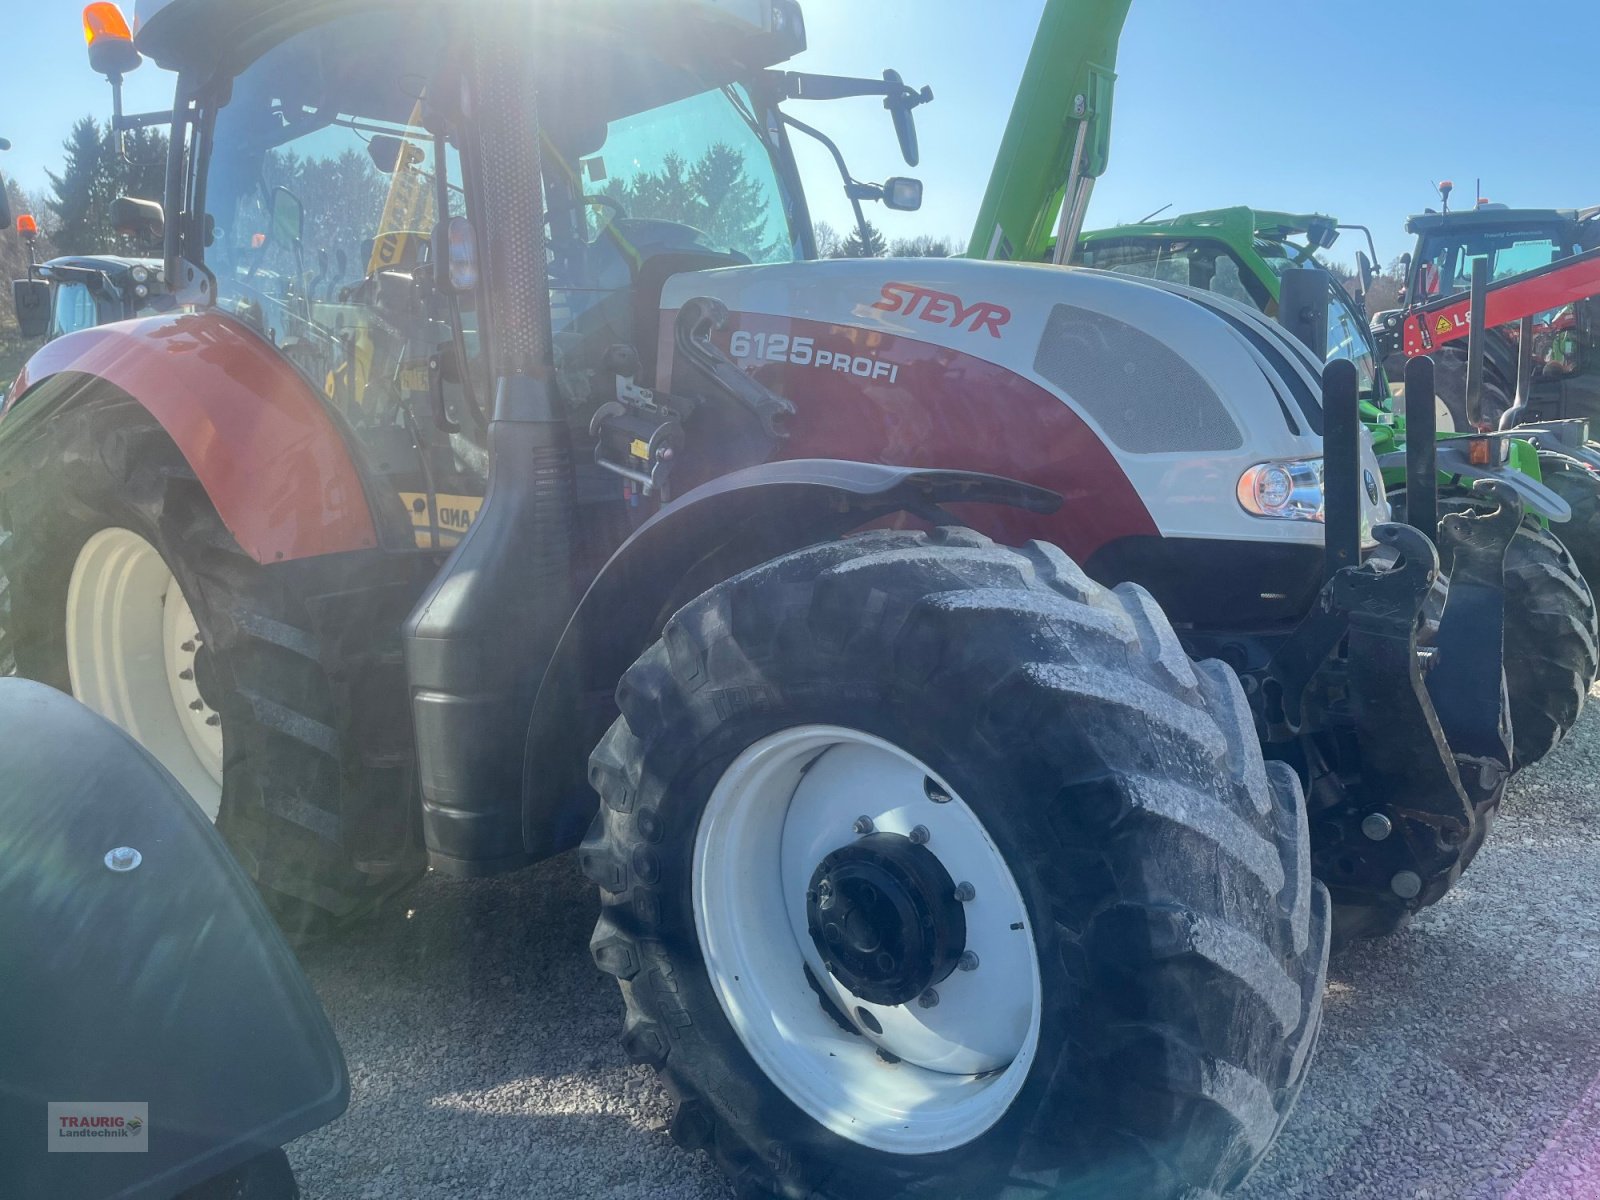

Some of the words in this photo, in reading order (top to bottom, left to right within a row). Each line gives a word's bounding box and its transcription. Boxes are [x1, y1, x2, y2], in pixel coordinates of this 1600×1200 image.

[872, 281, 1011, 338] STEYR
[729, 330, 815, 365] 6125
[815, 350, 899, 384] PROFI
